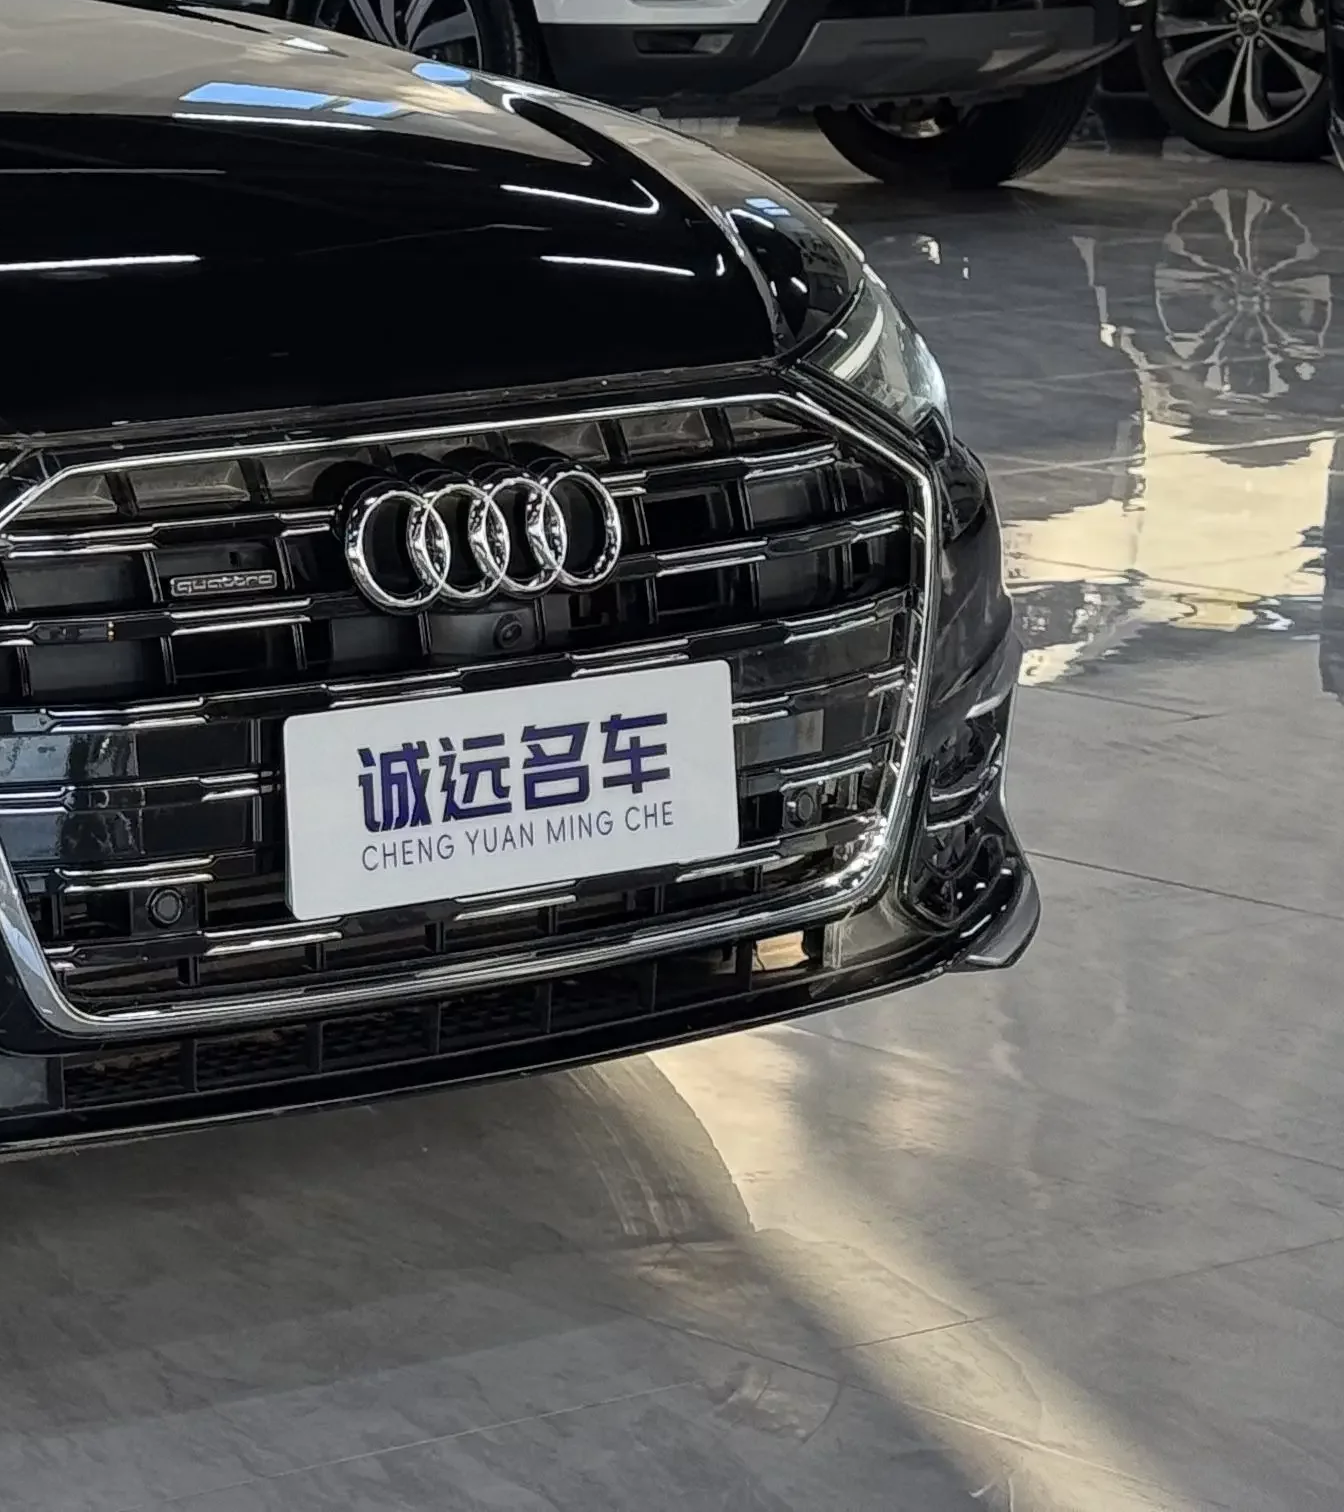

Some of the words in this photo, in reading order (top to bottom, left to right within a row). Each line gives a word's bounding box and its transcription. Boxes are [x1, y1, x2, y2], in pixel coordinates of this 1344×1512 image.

[176, 574, 273, 594] quattro
[357, 712, 671, 833] 诚远名车
[362, 834, 454, 871] CHENG
[465, 821, 534, 855] YUAN
[547, 810, 612, 844] MING
[624, 801, 673, 831] CHE
